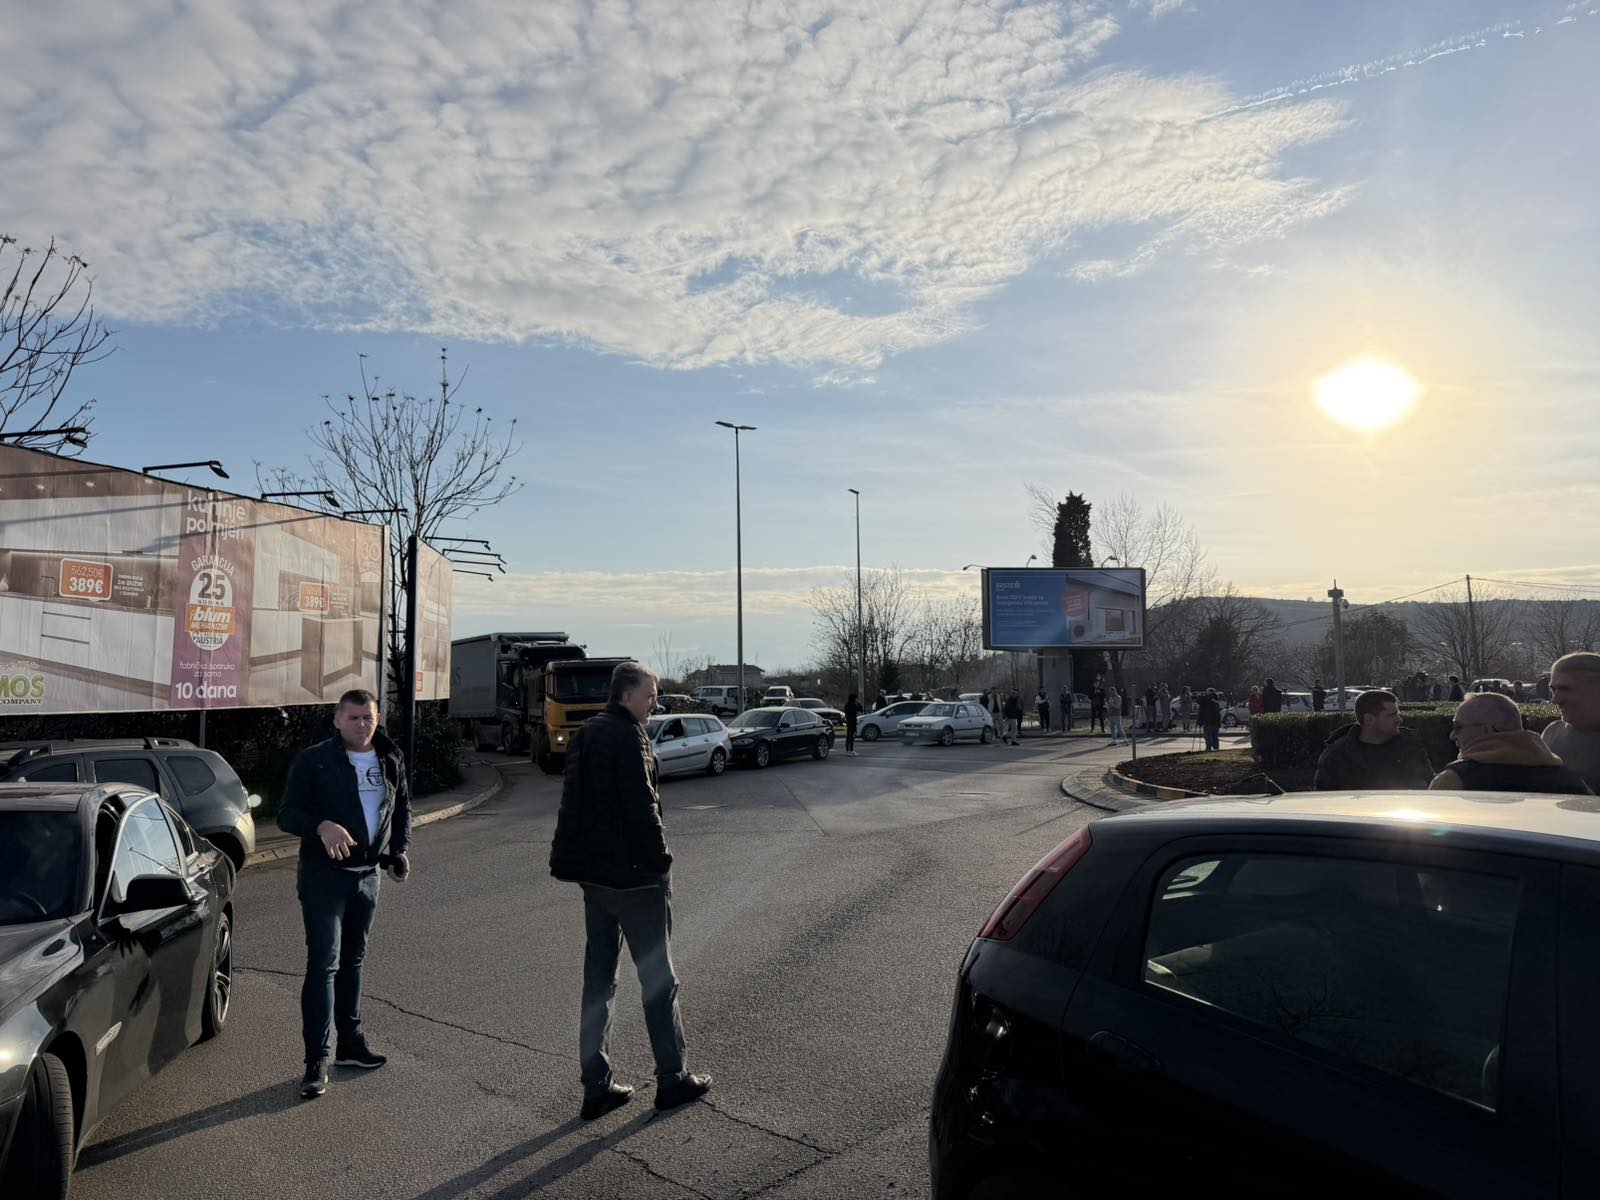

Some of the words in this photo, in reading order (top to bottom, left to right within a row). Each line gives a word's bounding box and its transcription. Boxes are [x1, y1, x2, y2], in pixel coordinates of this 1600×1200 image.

[187, 489, 246, 521] kuhinje
[186, 516, 207, 534] po
[191, 554, 236, 577] GARANCIJA
[69, 576, 104, 594] 389€
[198, 572, 226, 600] 25
[193, 606, 232, 624] blum
[195, 635, 224, 645] AUSTRIA
[175, 682, 193, 699] 10
[195, 681, 237, 699] dana
